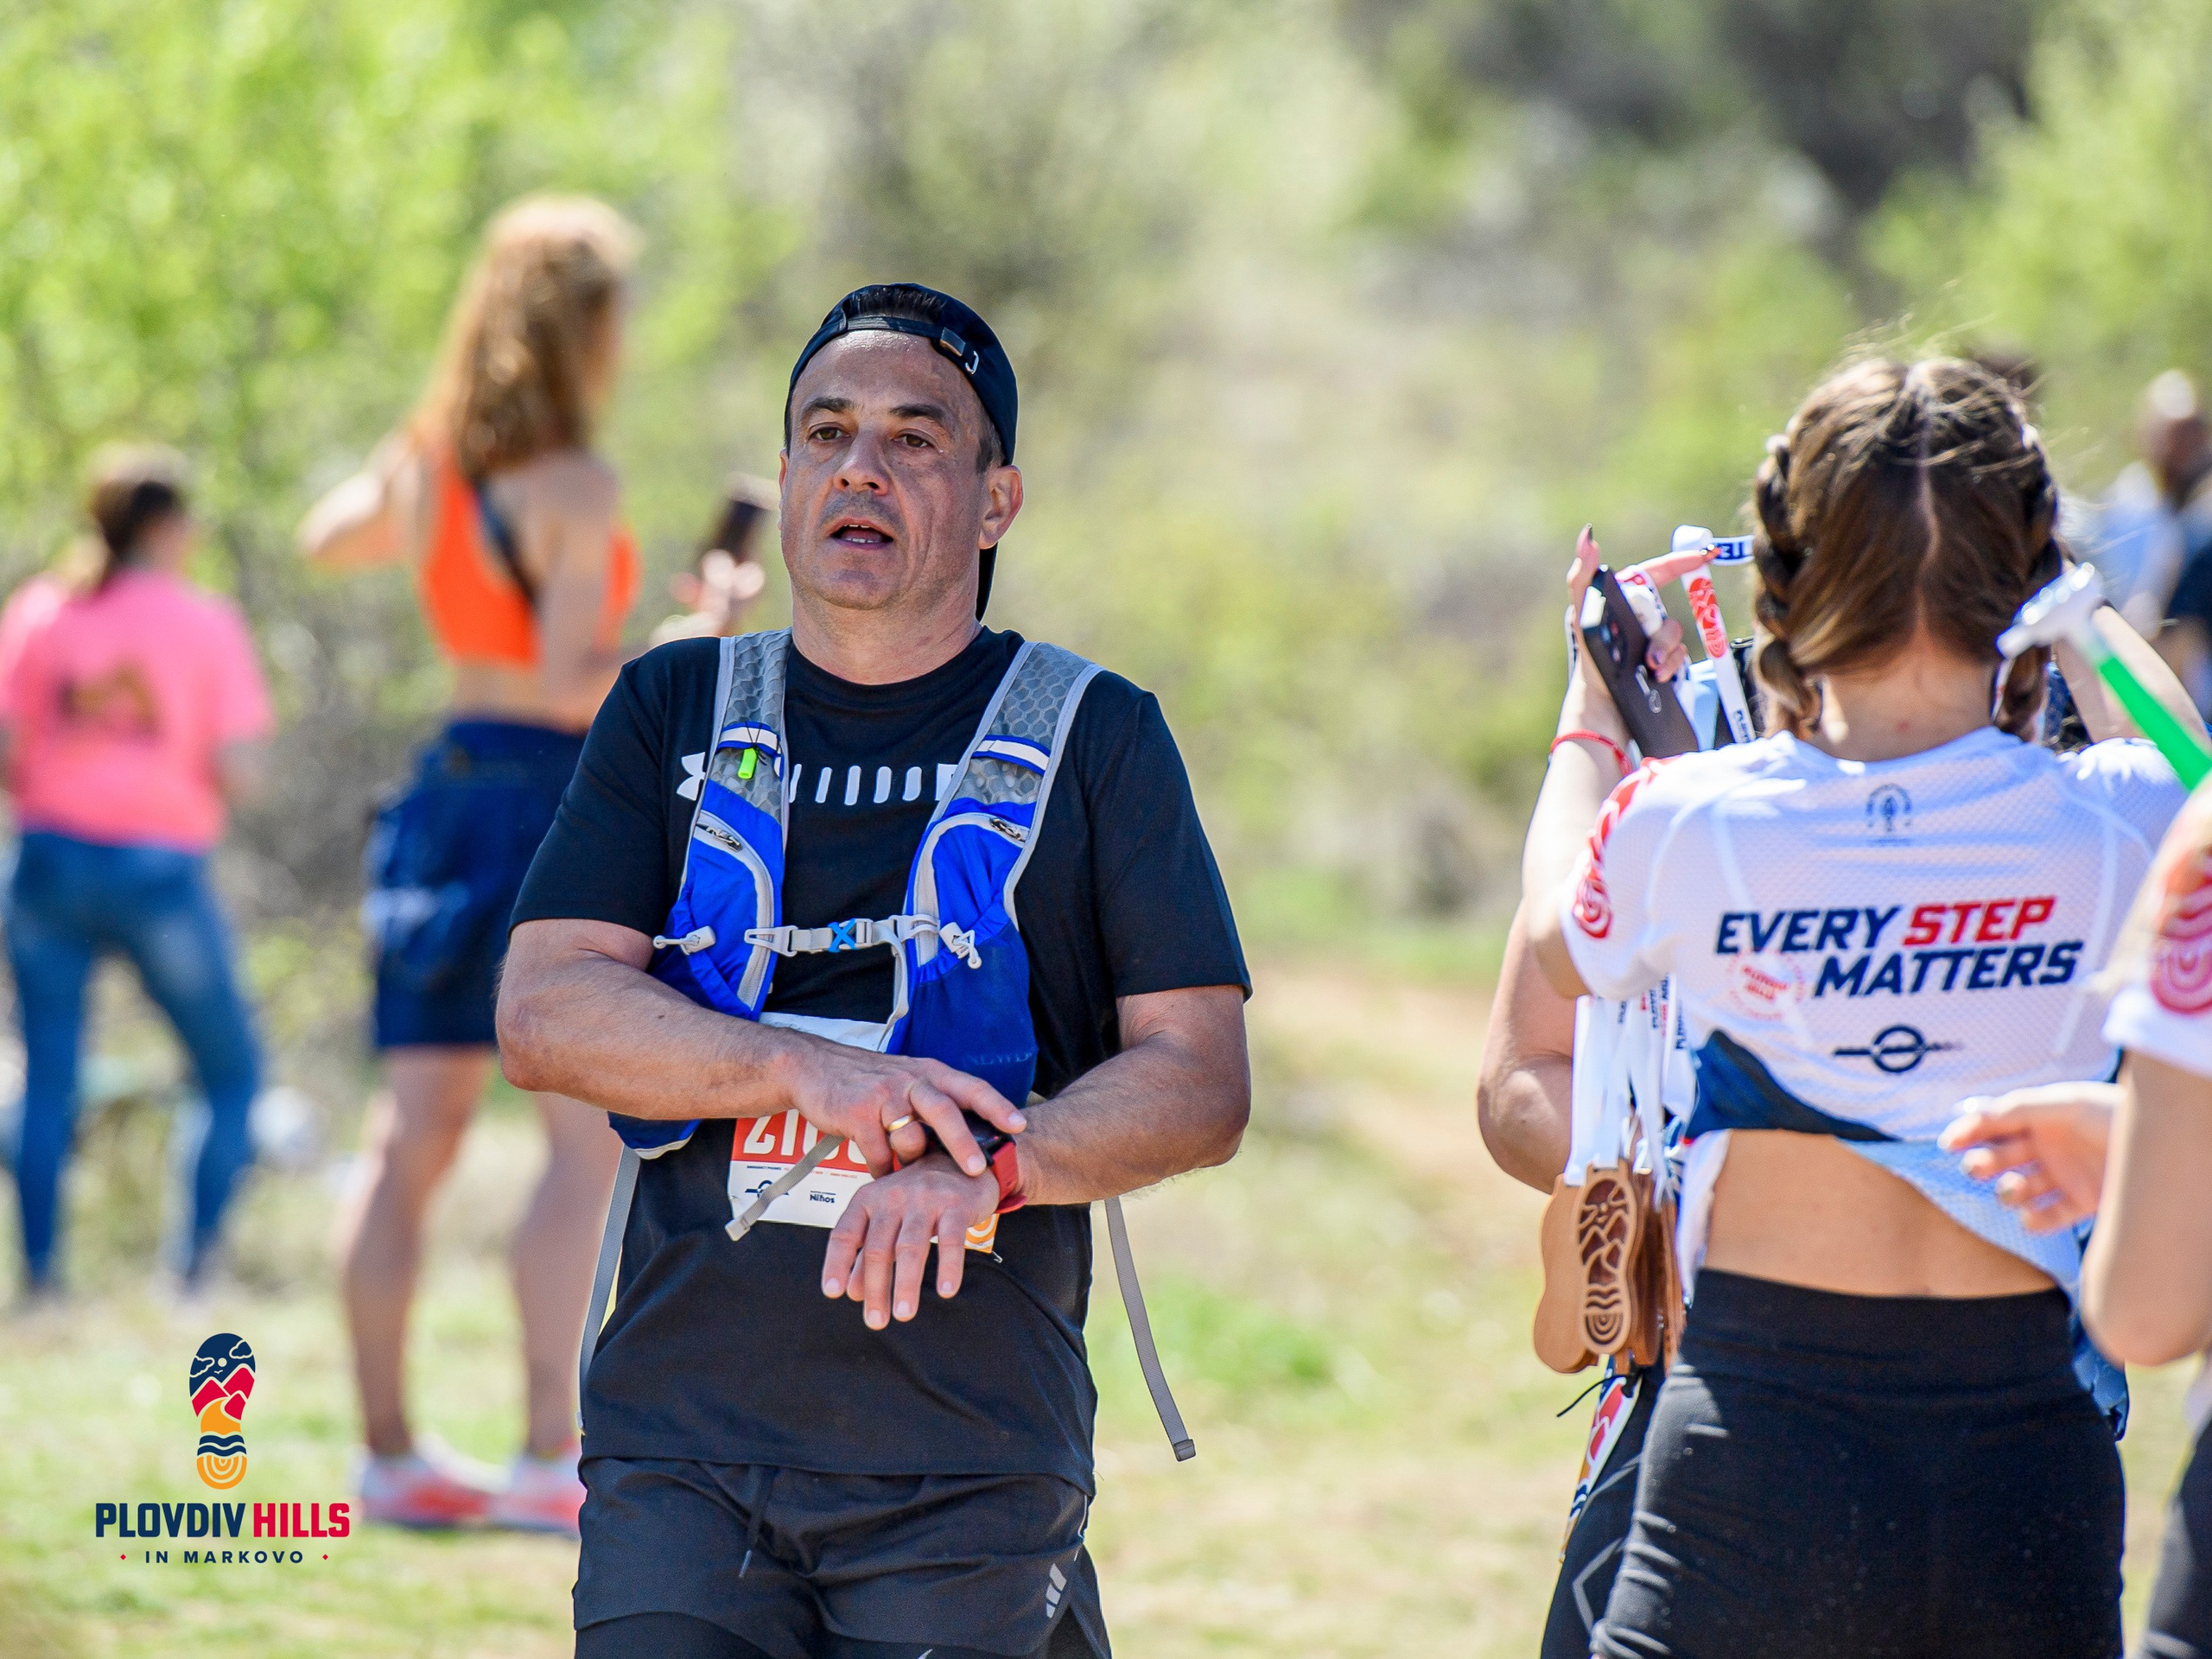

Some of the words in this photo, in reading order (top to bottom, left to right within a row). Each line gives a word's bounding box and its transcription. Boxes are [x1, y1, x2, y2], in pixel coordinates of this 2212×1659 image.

[1714, 905, 1901, 955] EVERY
[1903, 895, 2056, 946] STEP
[1811, 940, 2084, 999] MATTERS
